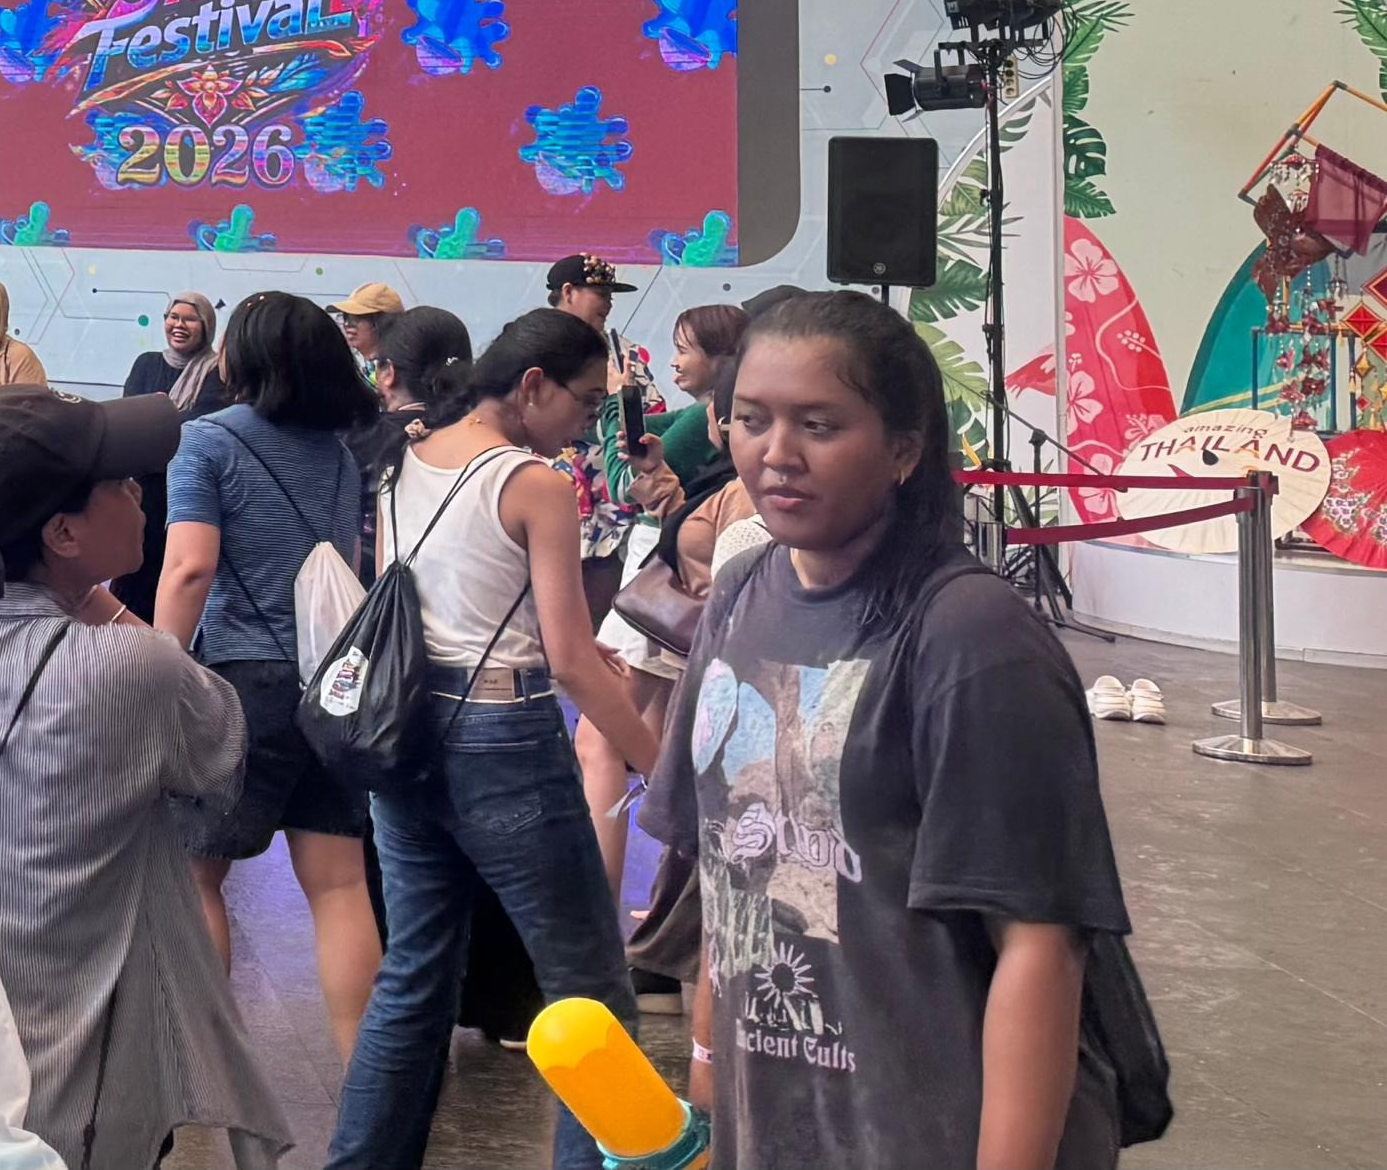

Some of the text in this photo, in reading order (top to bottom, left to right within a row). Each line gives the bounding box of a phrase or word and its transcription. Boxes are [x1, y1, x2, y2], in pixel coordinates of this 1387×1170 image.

[116, 123, 296, 187] 2026
[1183, 424, 1269, 439] amazing
[1140, 435, 1321, 473] THAILAND
[803, 1036, 857, 1073] Cults
